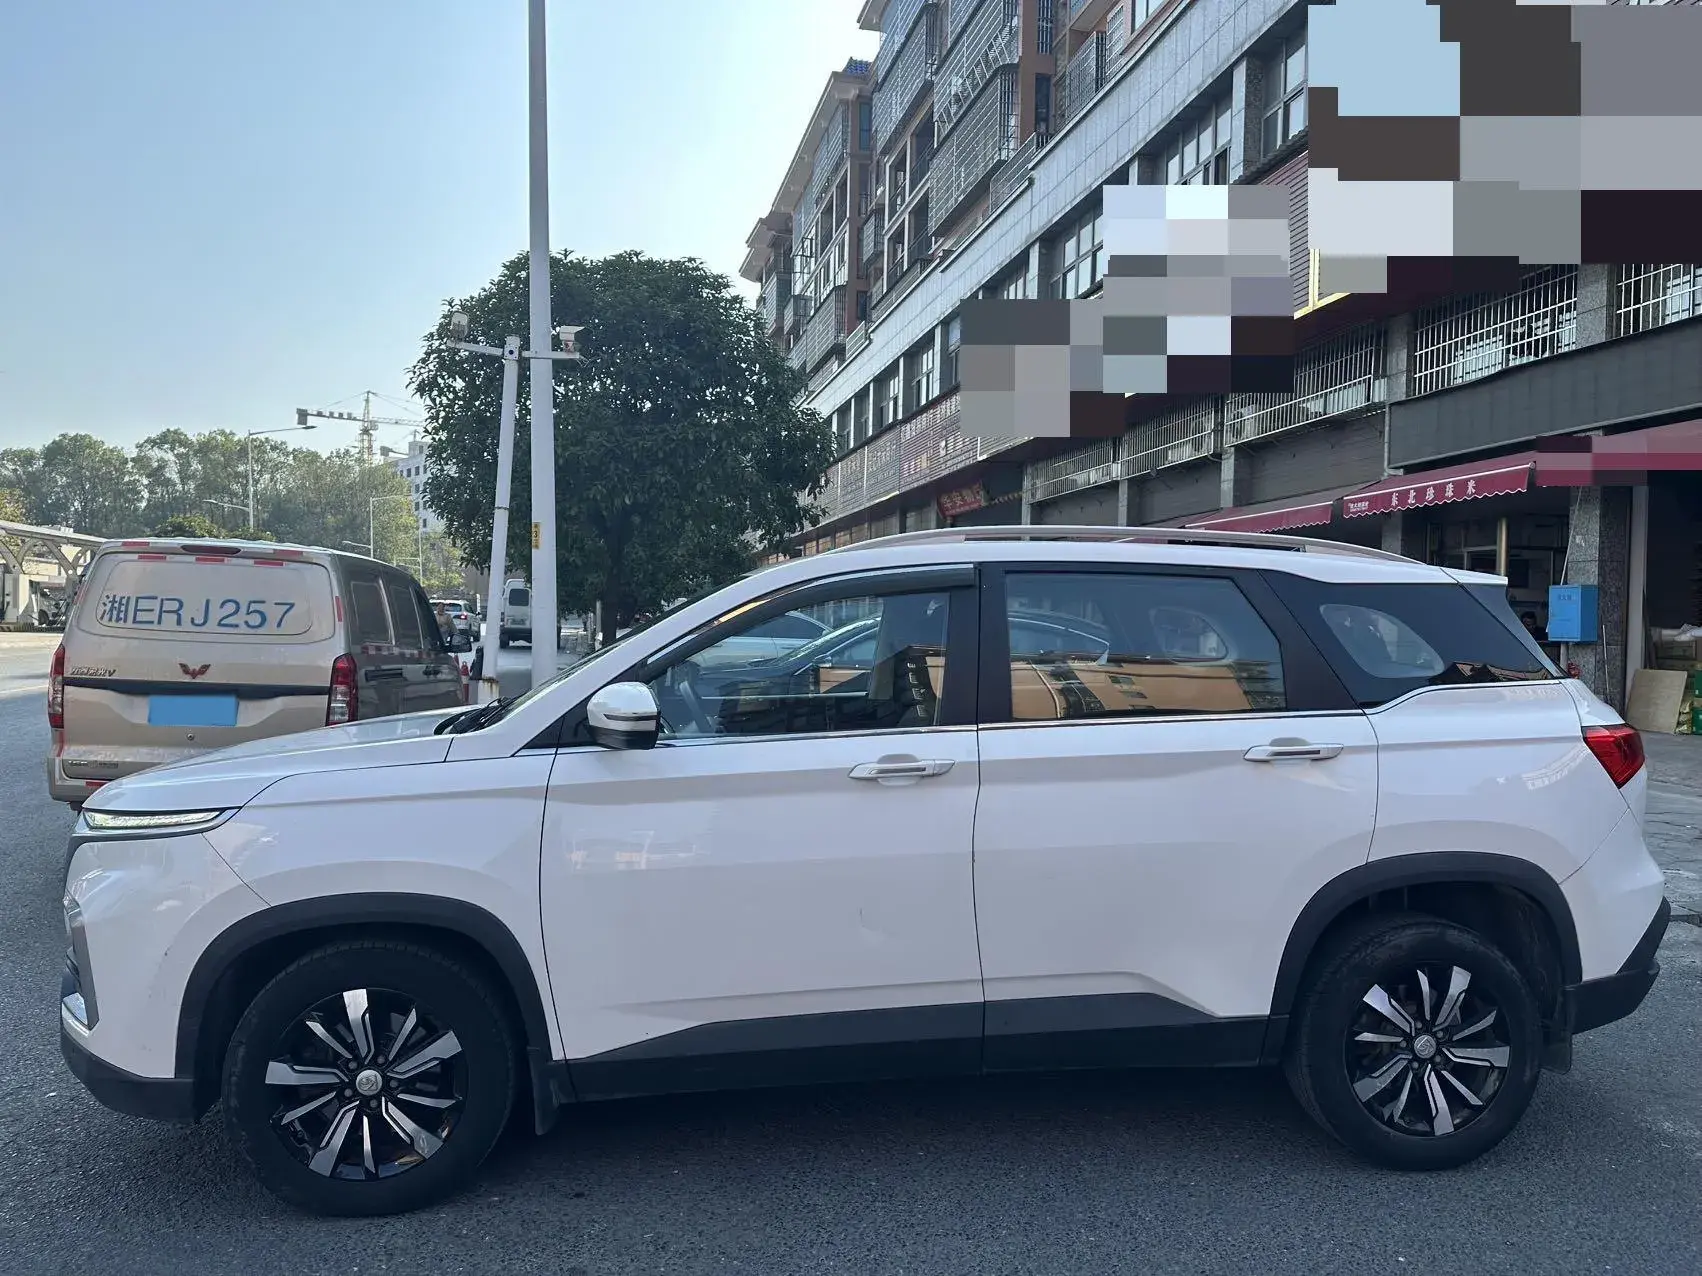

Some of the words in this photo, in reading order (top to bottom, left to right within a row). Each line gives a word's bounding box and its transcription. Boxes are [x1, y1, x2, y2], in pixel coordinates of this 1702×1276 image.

[1391, 479, 1476, 507] 东北珍珠米
[100, 594, 296, 629] 湘ERJ257
